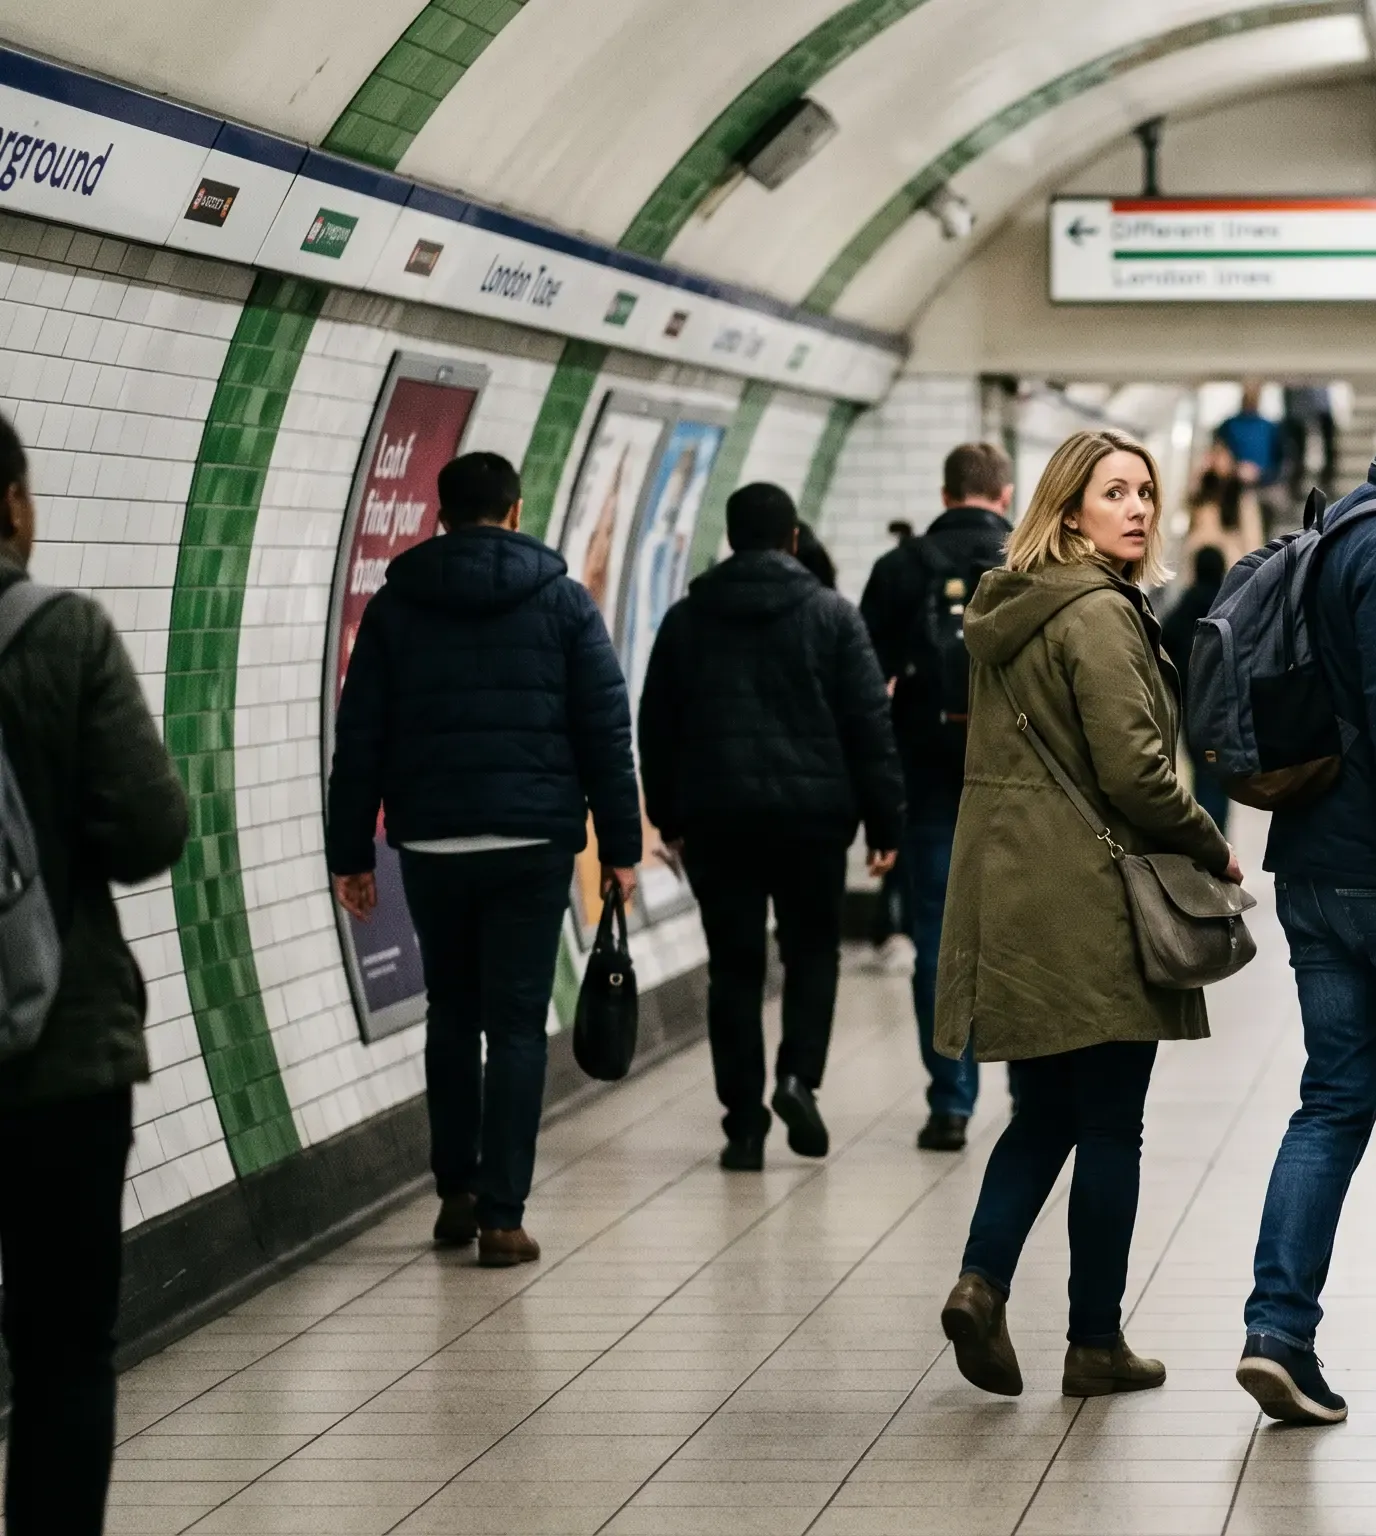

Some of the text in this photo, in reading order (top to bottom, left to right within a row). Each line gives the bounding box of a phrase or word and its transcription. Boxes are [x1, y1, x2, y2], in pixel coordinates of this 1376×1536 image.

[0, 127, 114, 196] rground
[361, 488, 427, 546] find your
